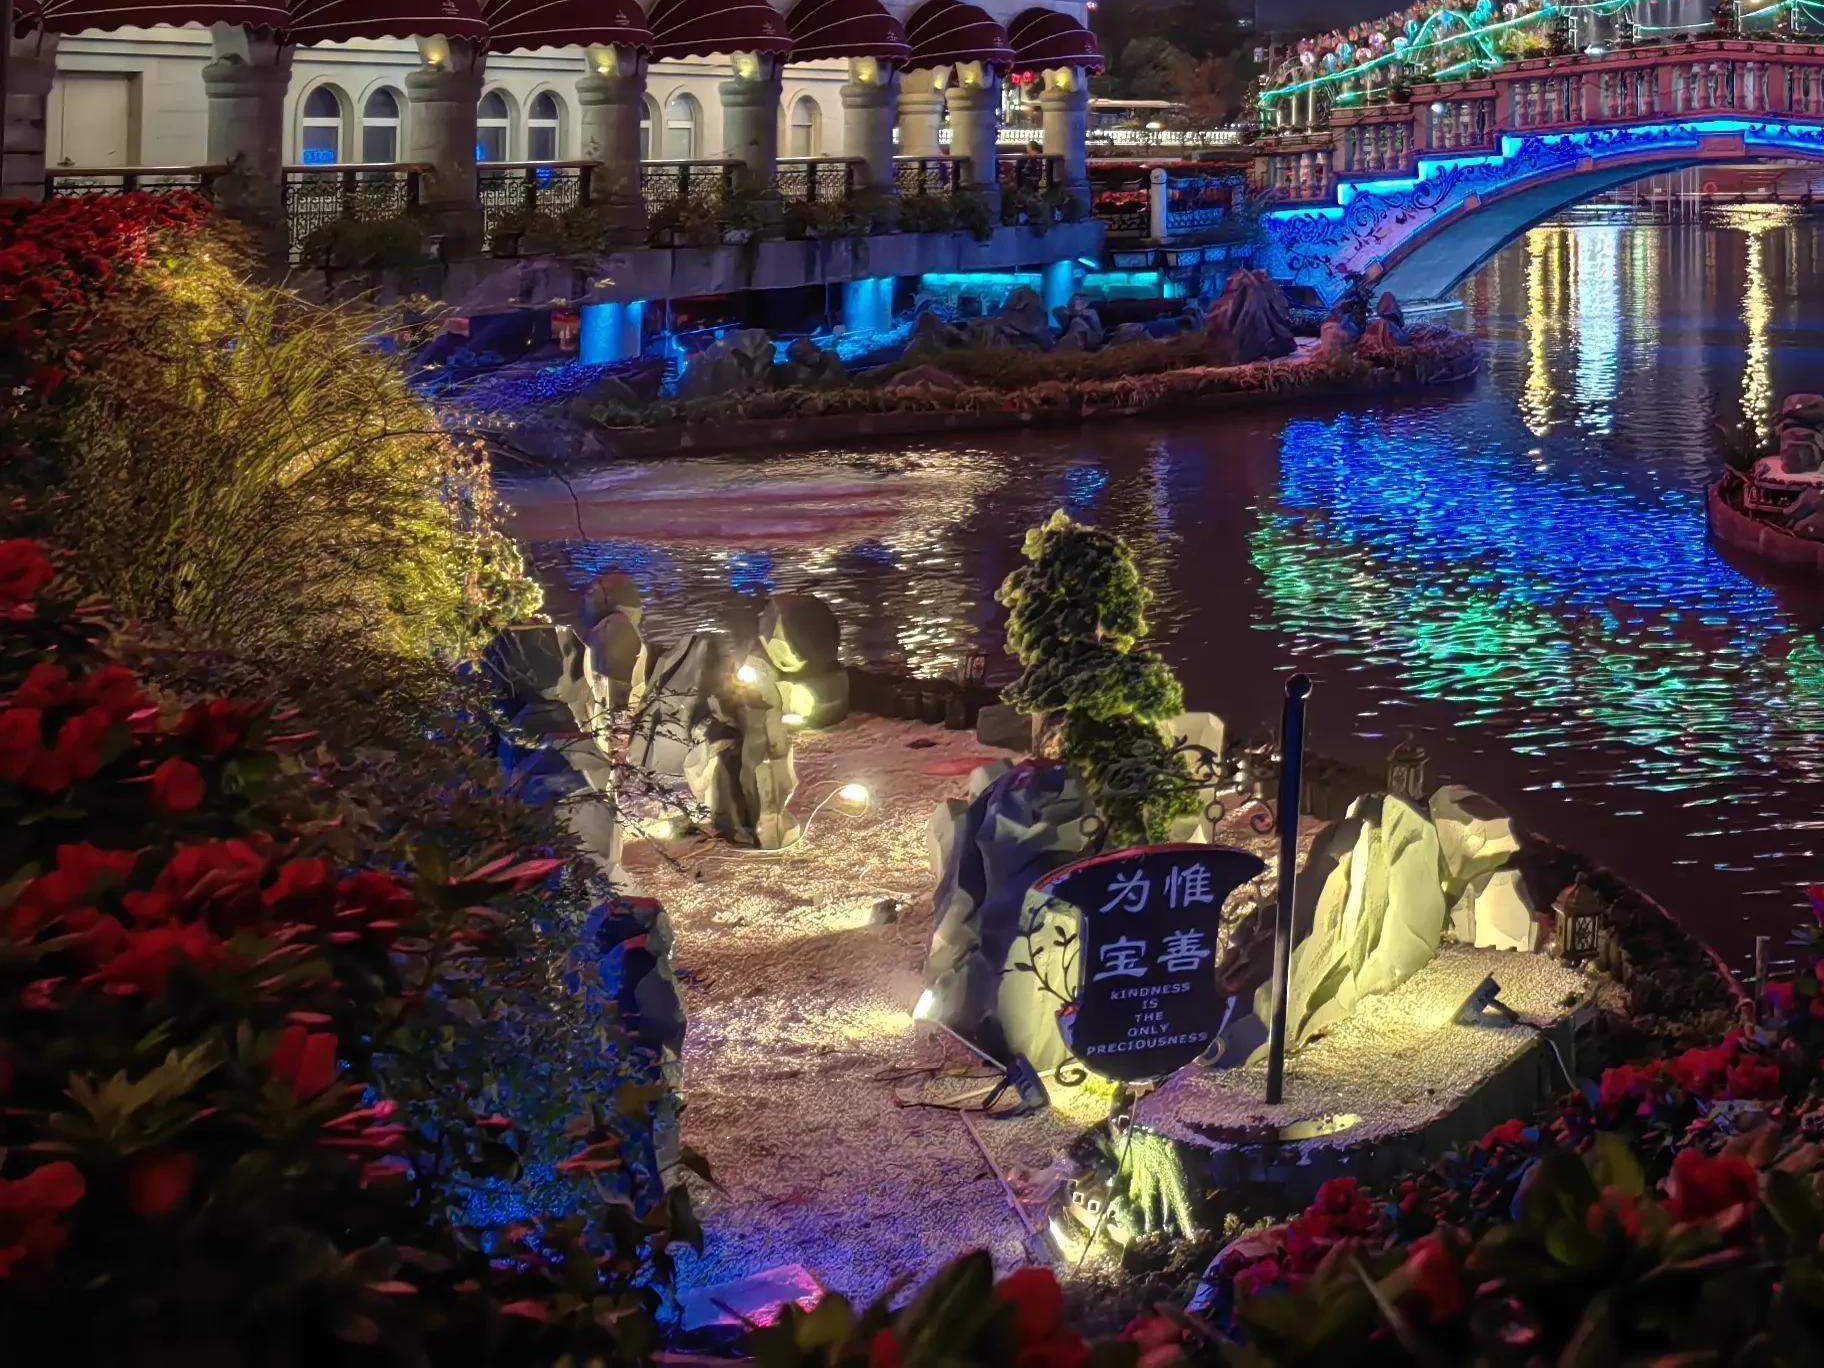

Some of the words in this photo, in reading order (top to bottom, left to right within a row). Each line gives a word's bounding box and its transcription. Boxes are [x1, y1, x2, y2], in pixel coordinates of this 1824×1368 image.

[1142, 998, 1158, 1009] IS
[1135, 1011, 1164, 1023] THE
[1127, 1023, 1169, 1037] ONLY
[1086, 1032, 1208, 1056] PRECIOUSNESS
